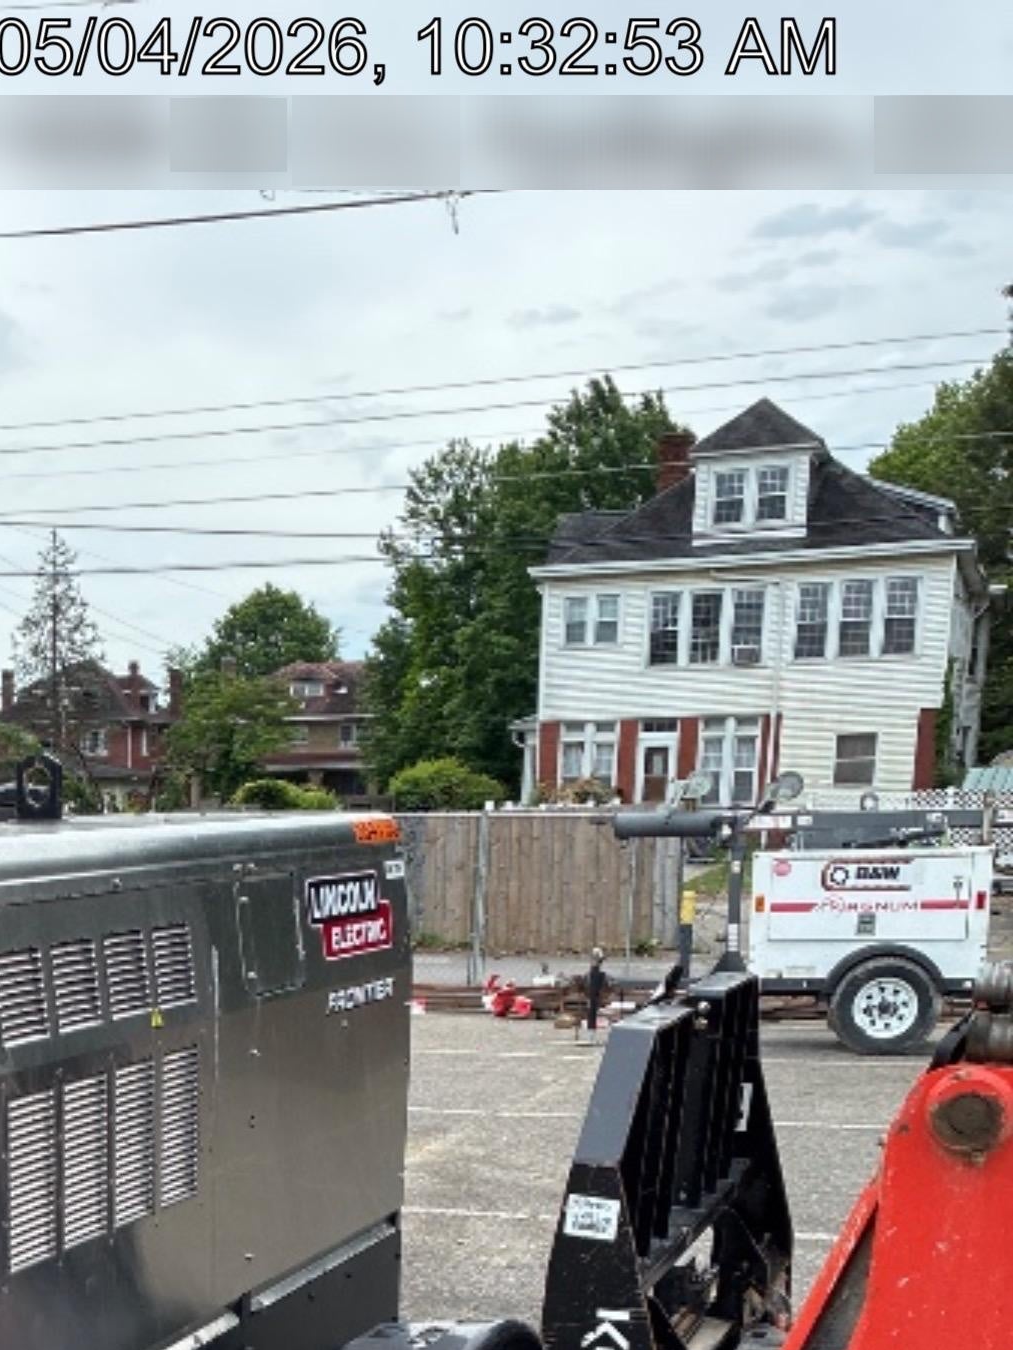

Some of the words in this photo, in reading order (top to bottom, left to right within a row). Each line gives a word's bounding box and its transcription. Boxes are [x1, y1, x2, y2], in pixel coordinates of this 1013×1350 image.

[310, 879, 377, 919] LINCOLN
[331, 917, 387, 951] ELECTRIC
[327, 977, 395, 1013] FRONTIER
